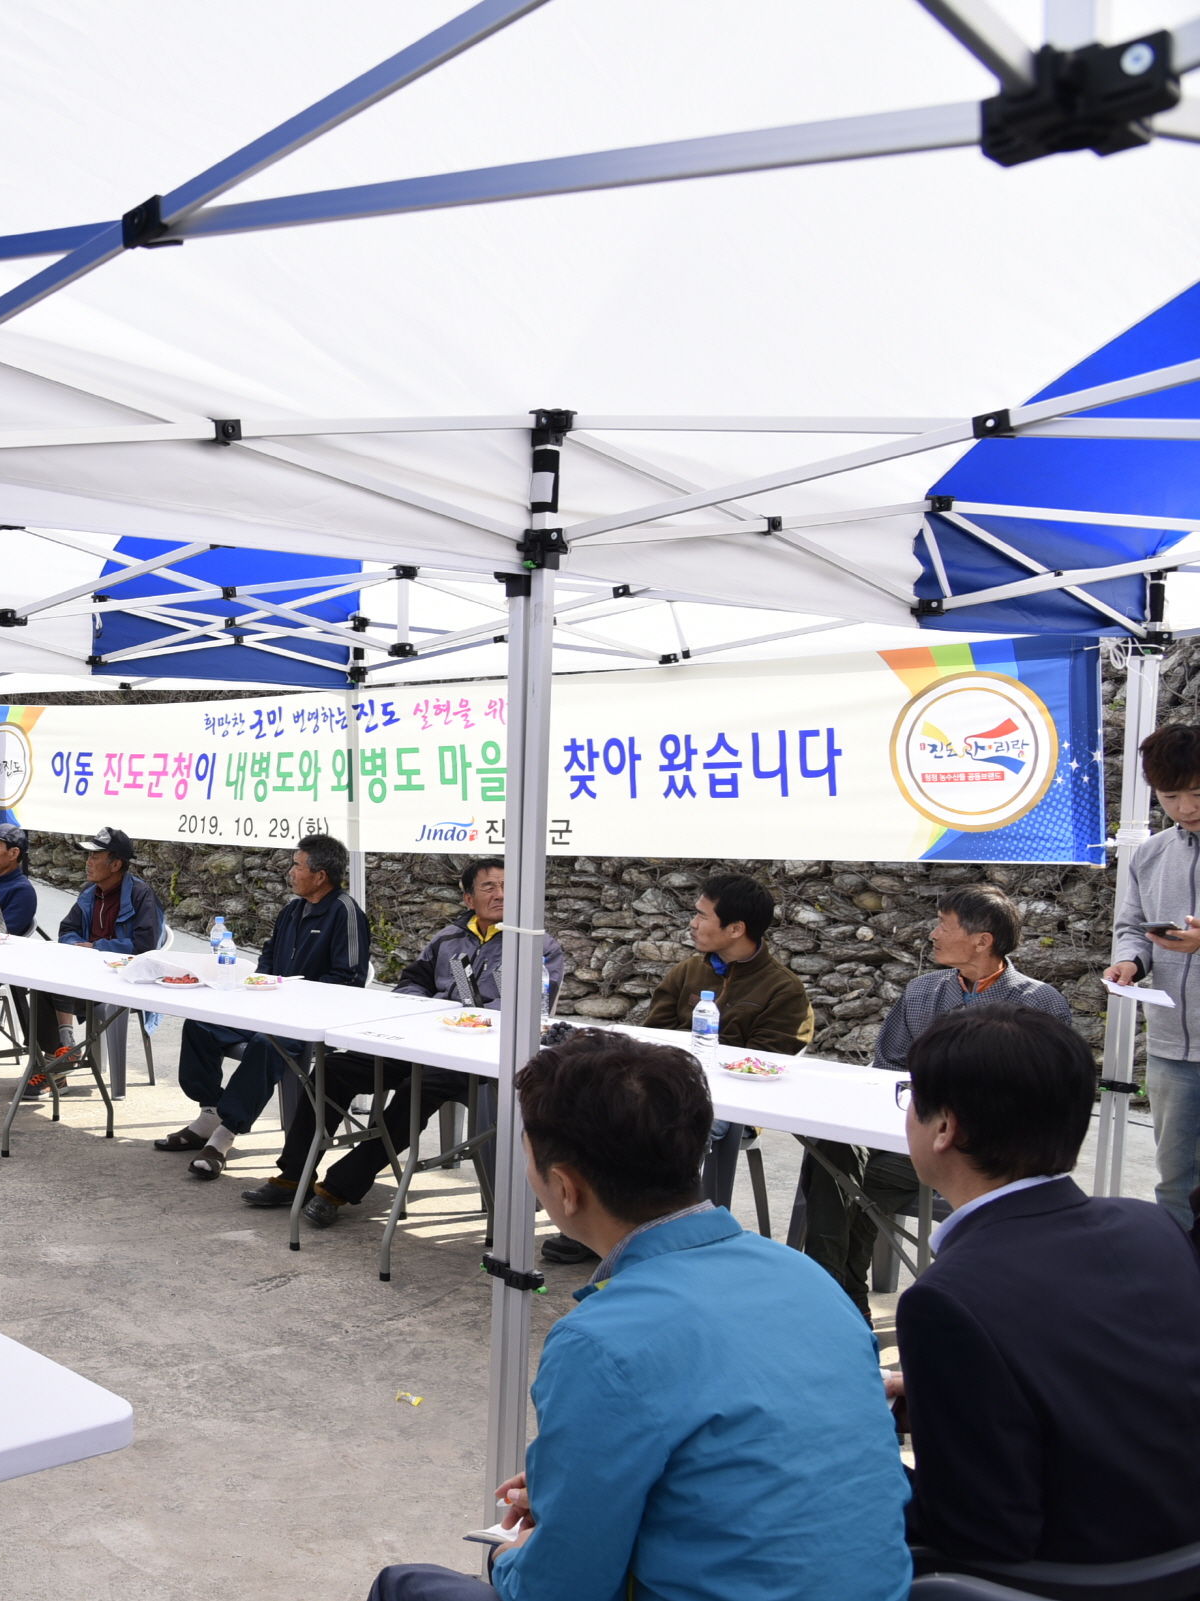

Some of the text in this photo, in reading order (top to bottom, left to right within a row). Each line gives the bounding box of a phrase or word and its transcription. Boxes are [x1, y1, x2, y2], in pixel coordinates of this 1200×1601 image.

[204, 698, 508, 739] 희망찬 군민 번영하는 진도 실현을 위
[2, 760, 24, 777] 진도
[51, 751, 94, 796] 이동
[103, 752, 217, 800] 진도군청이
[225, 750, 321, 802] 내병도와
[331, 747, 425, 803] 외병도
[563, 736, 642, 800] 찾아
[659, 727, 842, 799] 왔습니다
[178, 814, 223, 836] 2019.
[234, 817, 258, 838] 10.
[415, 824, 467, 842] Jindo
